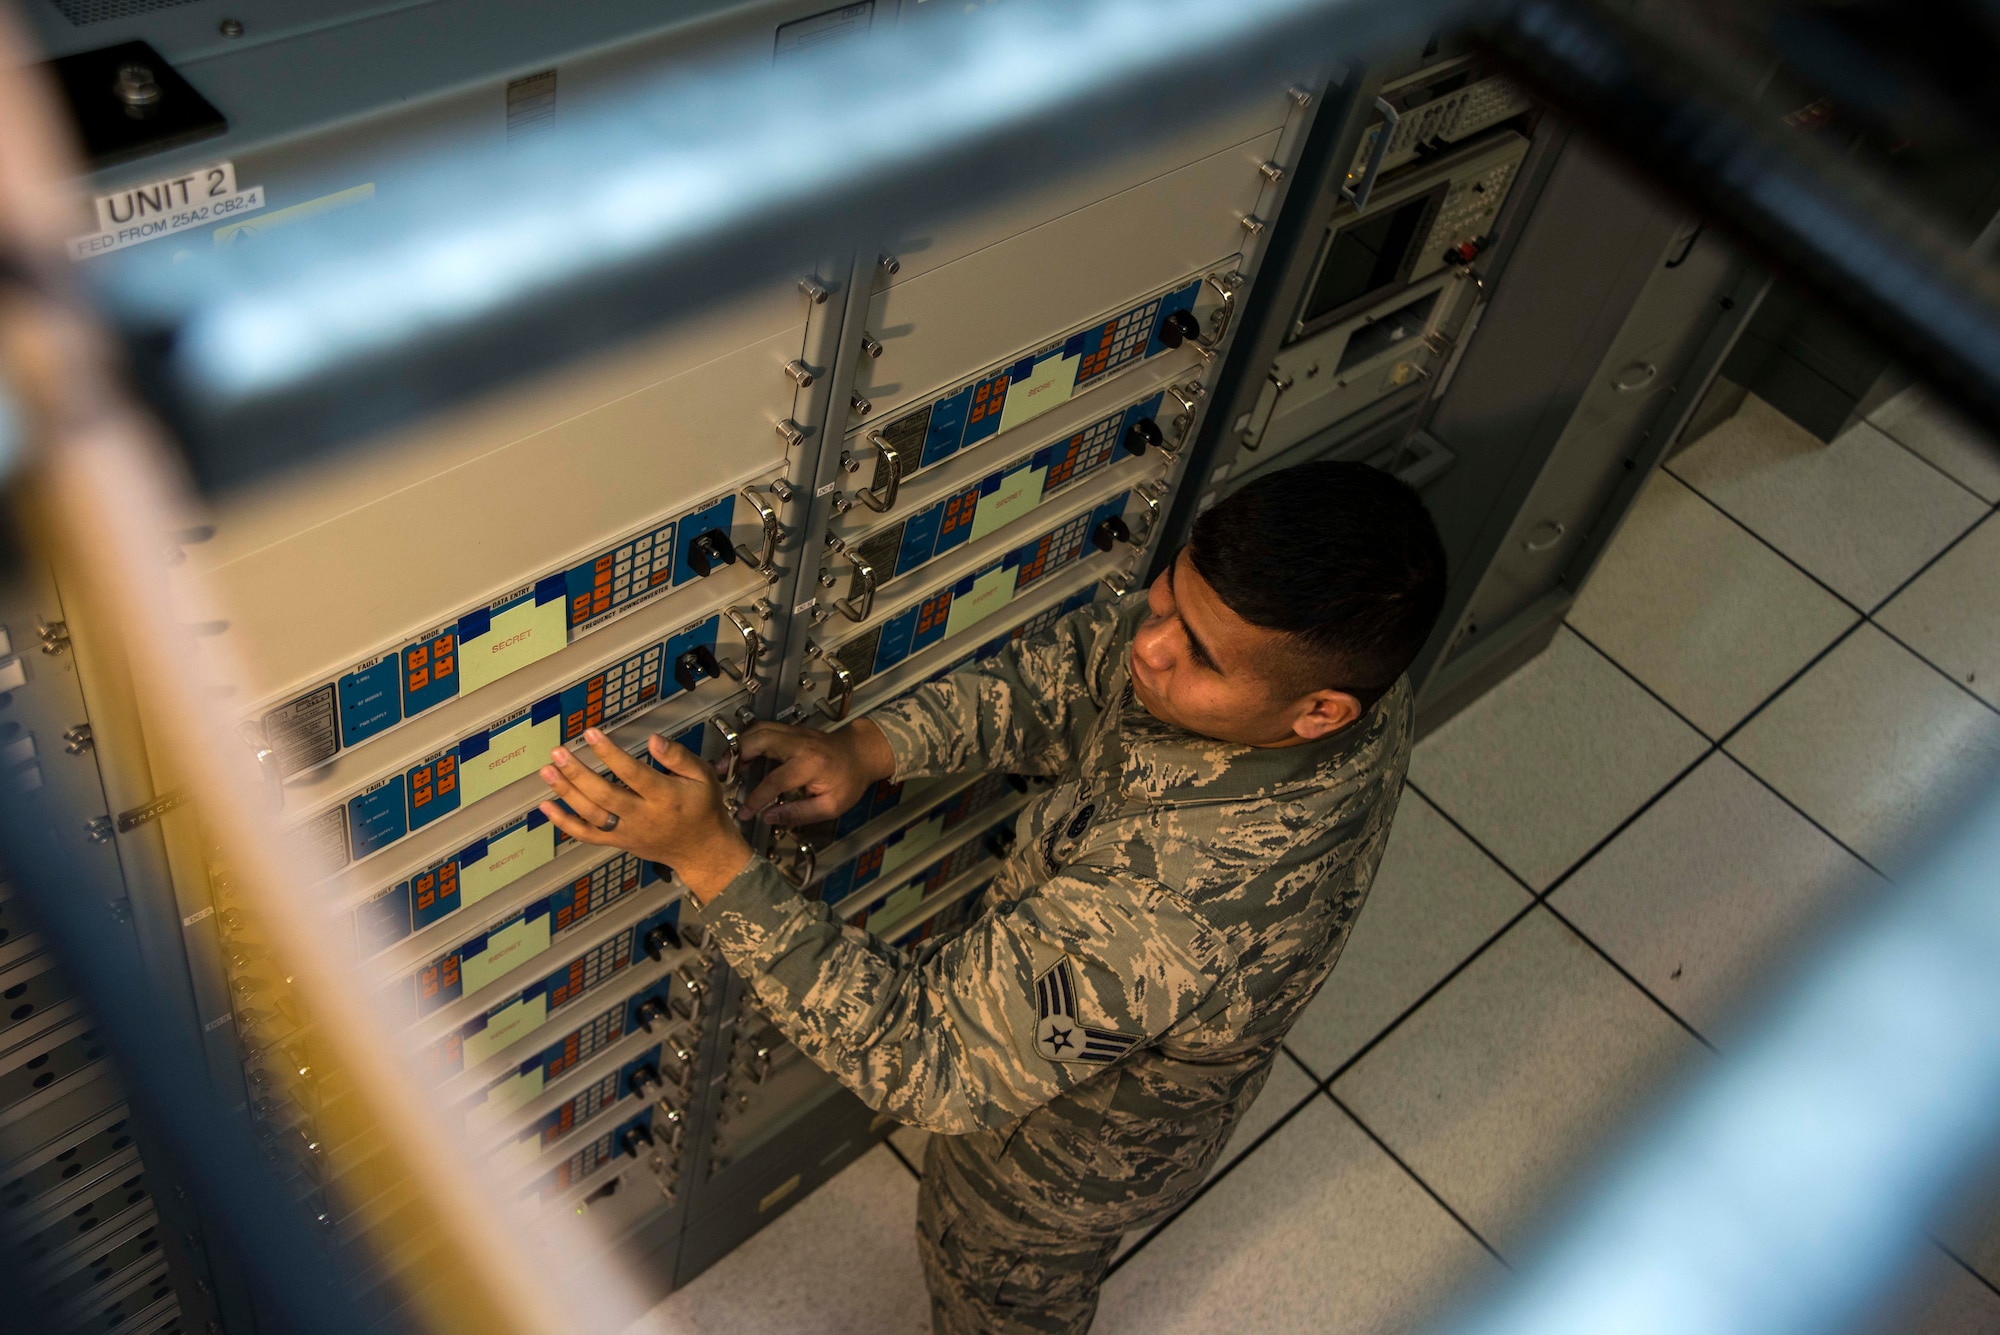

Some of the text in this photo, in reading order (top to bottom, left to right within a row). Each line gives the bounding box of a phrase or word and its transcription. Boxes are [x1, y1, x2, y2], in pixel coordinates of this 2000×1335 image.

[109, 169, 228, 223] UNIT 2
[78, 235, 114, 254] FED
[119, 219, 167, 243] FROM
[172, 207, 209, 228] 25A2
[698, 499, 719, 512] POWER
[492, 587, 530, 609] DATA ENTRY
[582, 584, 669, 632] FREQUENCY DOWNCONVERTER
[421, 629, 440, 642] MODE
[492, 629, 532, 653] SECRET
[357, 657, 379, 672] FAULT
[491, 708, 527, 730] DATA ENTRY
[425, 751, 442, 763] MODE
[489, 746, 527, 770] SECRET
[366, 780, 386, 794] FAULT
[489, 848, 525, 872] SECRET
